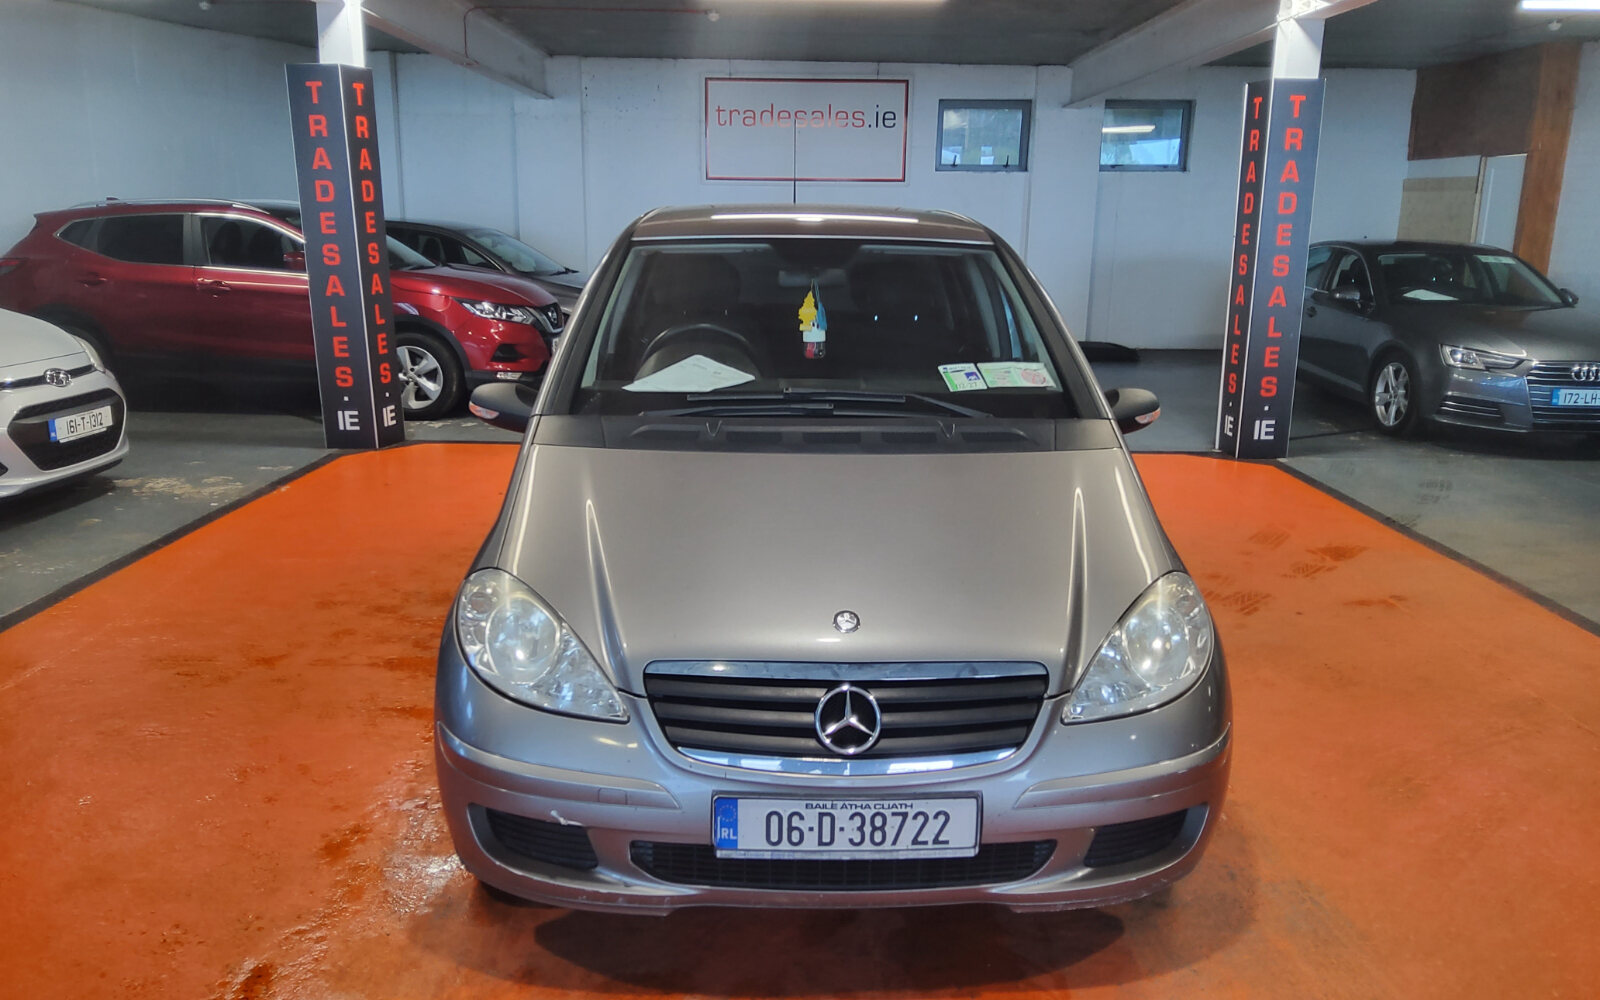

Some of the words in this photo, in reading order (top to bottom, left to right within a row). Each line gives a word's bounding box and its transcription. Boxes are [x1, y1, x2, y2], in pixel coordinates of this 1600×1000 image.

[715, 102, 897, 128] tradesales.ie
[66, 412, 104, 435] 161-T-1312
[805, 802, 837, 810] BAILE
[765, 810, 950, 847] 06-D-38722
